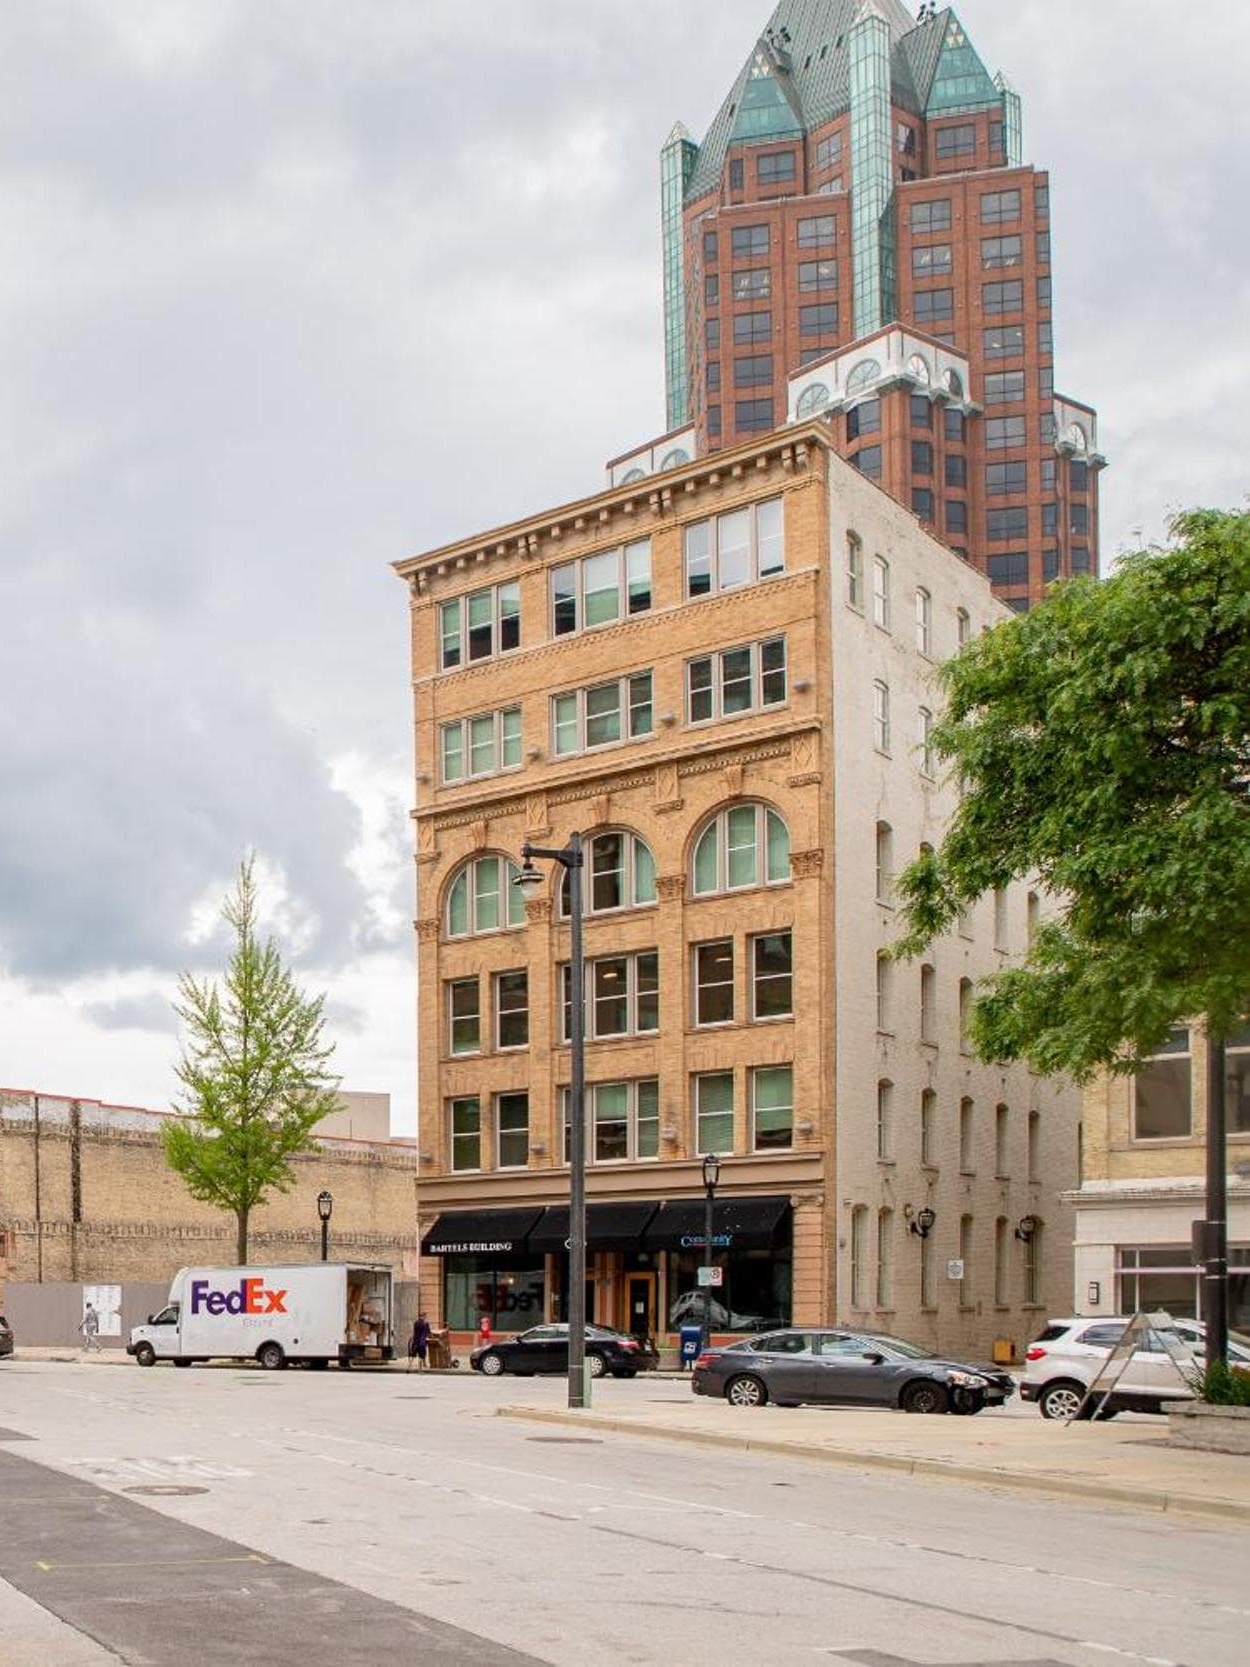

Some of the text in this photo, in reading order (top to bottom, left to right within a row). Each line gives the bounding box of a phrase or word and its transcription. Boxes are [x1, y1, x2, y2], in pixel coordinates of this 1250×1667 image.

[430, 1241, 513, 1253] BARTELS BUILDING
[191, 1278, 287, 1315] FedEx
